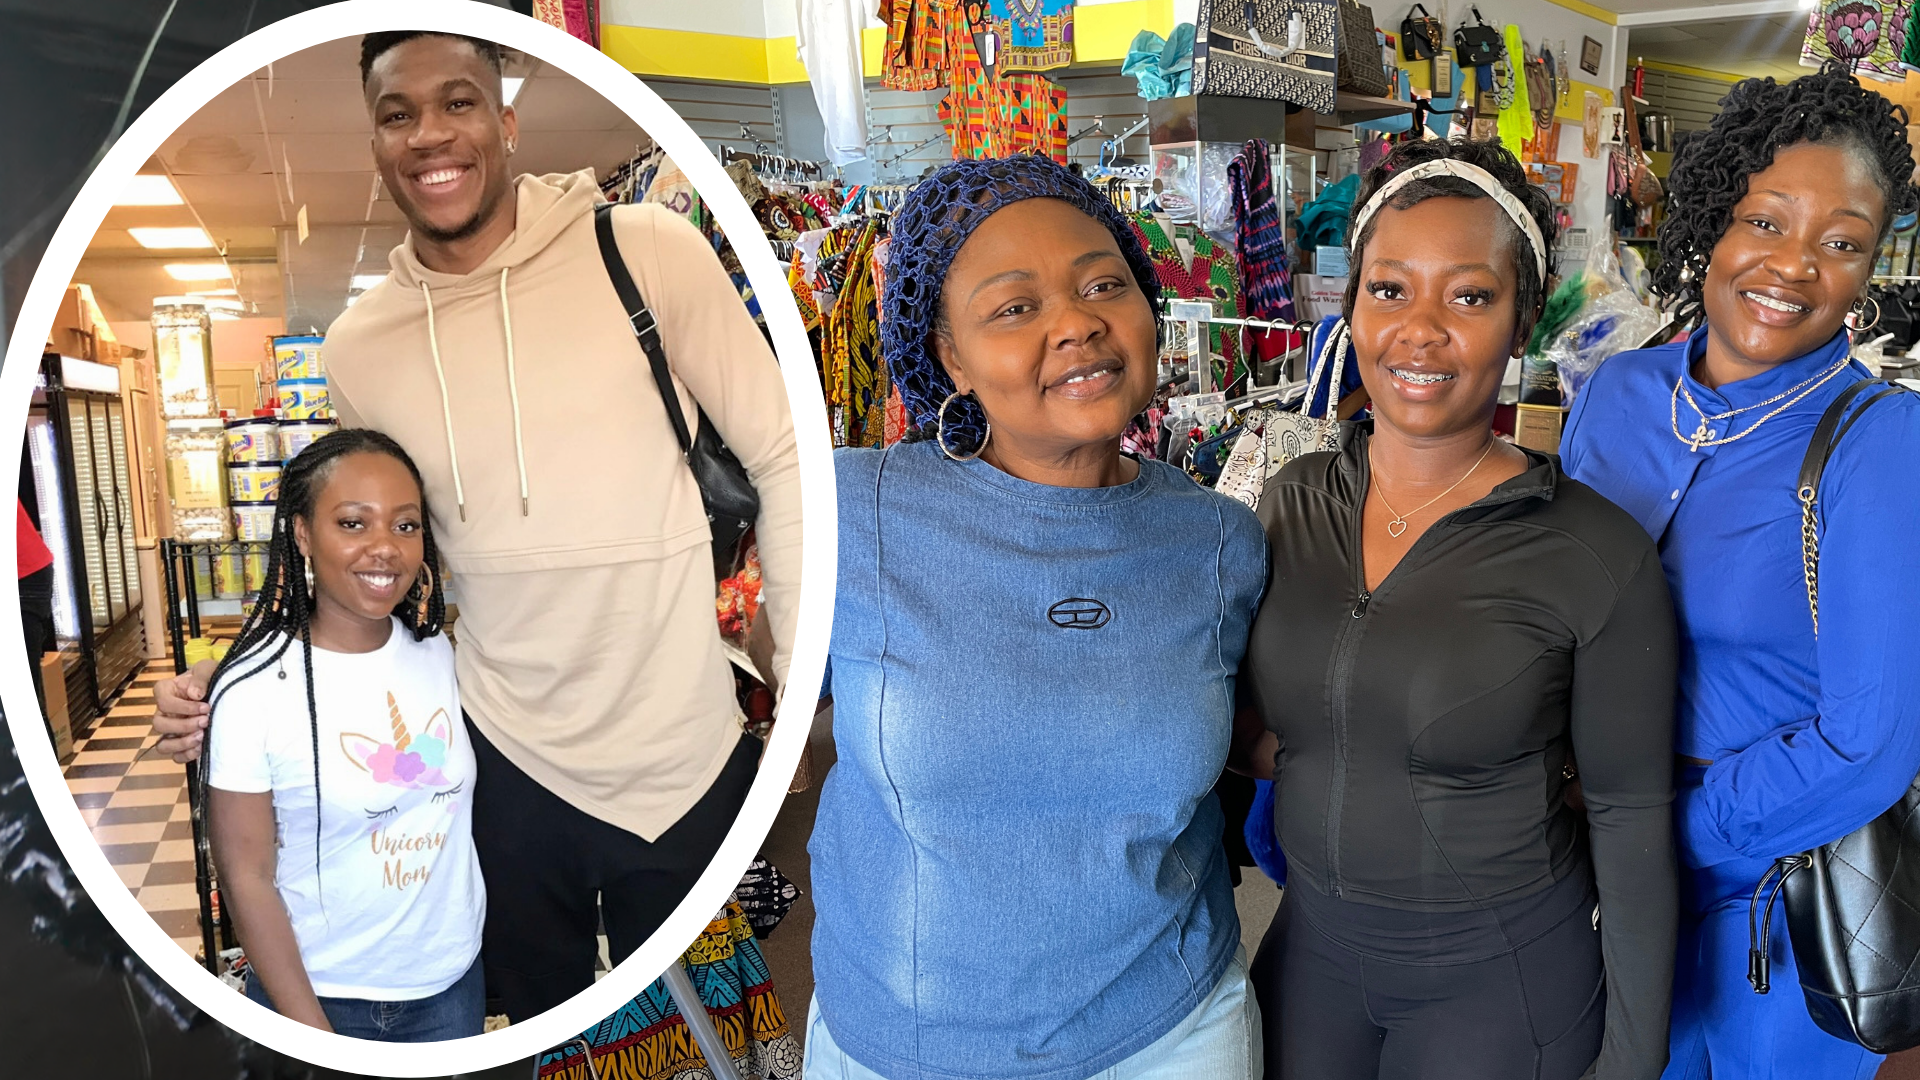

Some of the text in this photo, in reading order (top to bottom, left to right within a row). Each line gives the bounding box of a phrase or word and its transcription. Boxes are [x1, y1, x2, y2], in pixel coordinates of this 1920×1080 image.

[1286, 53, 1307, 68] DIOR
[371, 826, 446, 856] Unicorn
[382, 858, 431, 891] Mom
